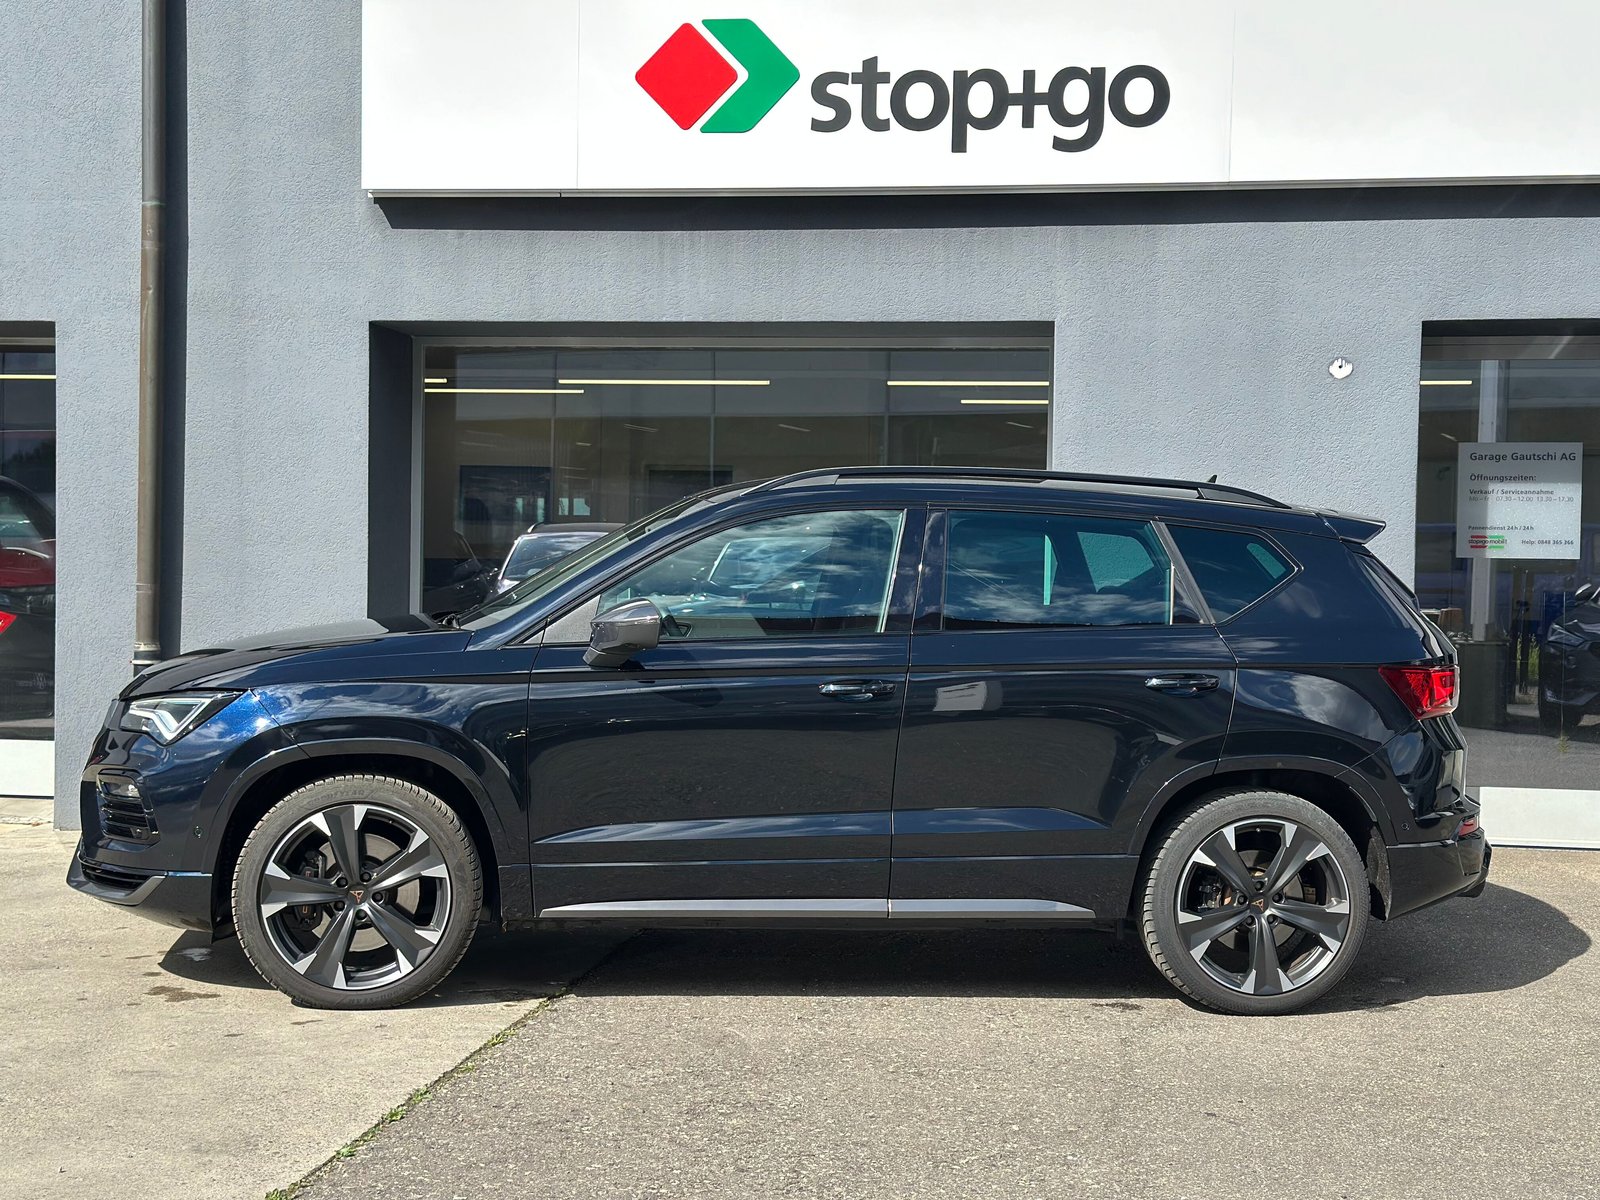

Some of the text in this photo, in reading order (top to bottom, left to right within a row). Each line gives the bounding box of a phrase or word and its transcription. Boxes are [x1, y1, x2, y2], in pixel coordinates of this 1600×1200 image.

[810, 55, 1171, 153] stop+go
[1470, 452, 1576, 462] Garage Gautschi AG
[1470, 473, 1536, 482] Öffnungszeiten:
